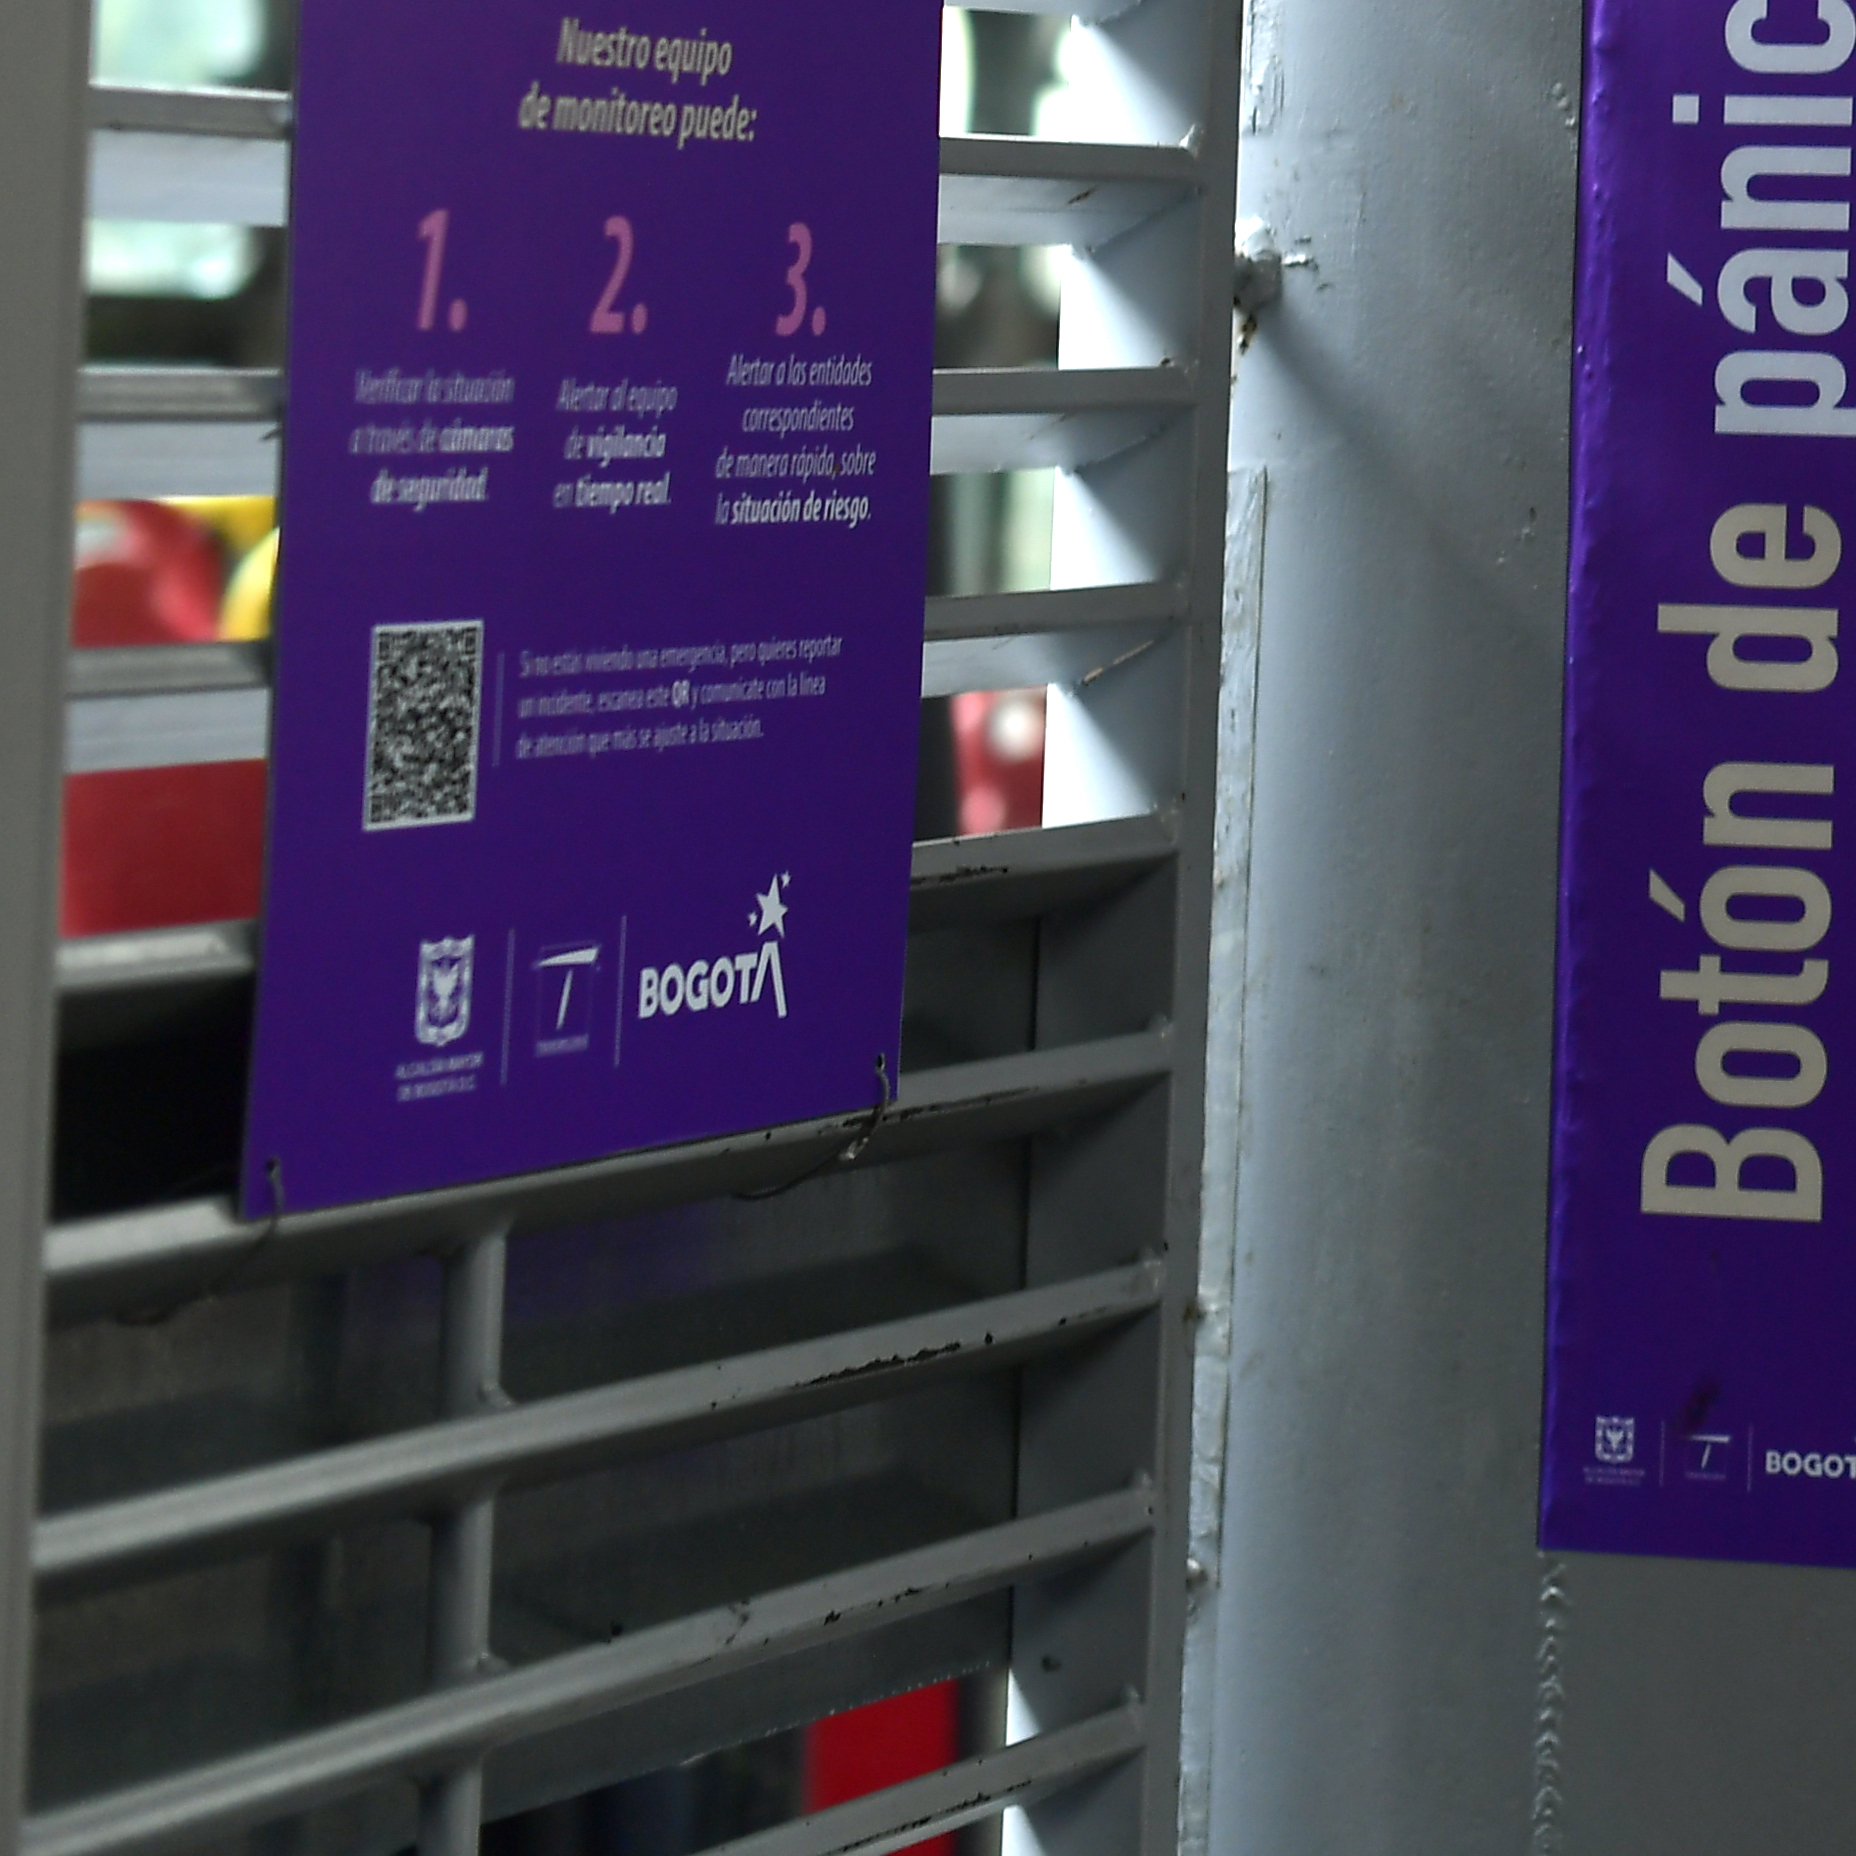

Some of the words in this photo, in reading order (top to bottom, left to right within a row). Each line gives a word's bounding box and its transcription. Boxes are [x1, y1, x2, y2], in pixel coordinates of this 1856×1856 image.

[556, 16, 651, 70] Nuestro
[654, 27, 733, 87] equipo
[518, 80, 551, 130] de
[552, 86, 677, 137] monitoreo
[677, 93, 757, 151] puede:
[416, 208, 468, 333] 1.
[589, 214, 649, 335] 2.
[774, 221, 827, 337] 3.
[726, 353, 774, 386] Alertar
[775, 361, 786, 386] a
[787, 353, 807, 386] las
[809, 353, 872, 386] entidades
[556, 377, 609, 411] Alertar
[628, 377, 678, 420] equipo
[742, 399, 855, 439] correspondientes
[564, 425, 586, 460] de
[587, 424, 666, 469] vigilancia
[715, 445, 734, 479] de
[735, 452, 790, 477] manera
[840, 442, 877, 476] sobre
[553, 482, 574, 508] en
[575, 473, 634, 515] tiempo
[635, 470, 672, 505] real.
[714, 492, 730, 525] la
[731, 489, 800, 525] situación
[802, 489, 822, 521] de
[823, 488, 872, 529] riesgo.
[1657, 503, 1842, 694] de
[758, 636, 797, 666] quieres
[798, 634, 842, 663] reportar
[766, 679, 786, 699] con
[787, 672, 798, 697] la
[1641, 760, 1834, 1223] Botón
